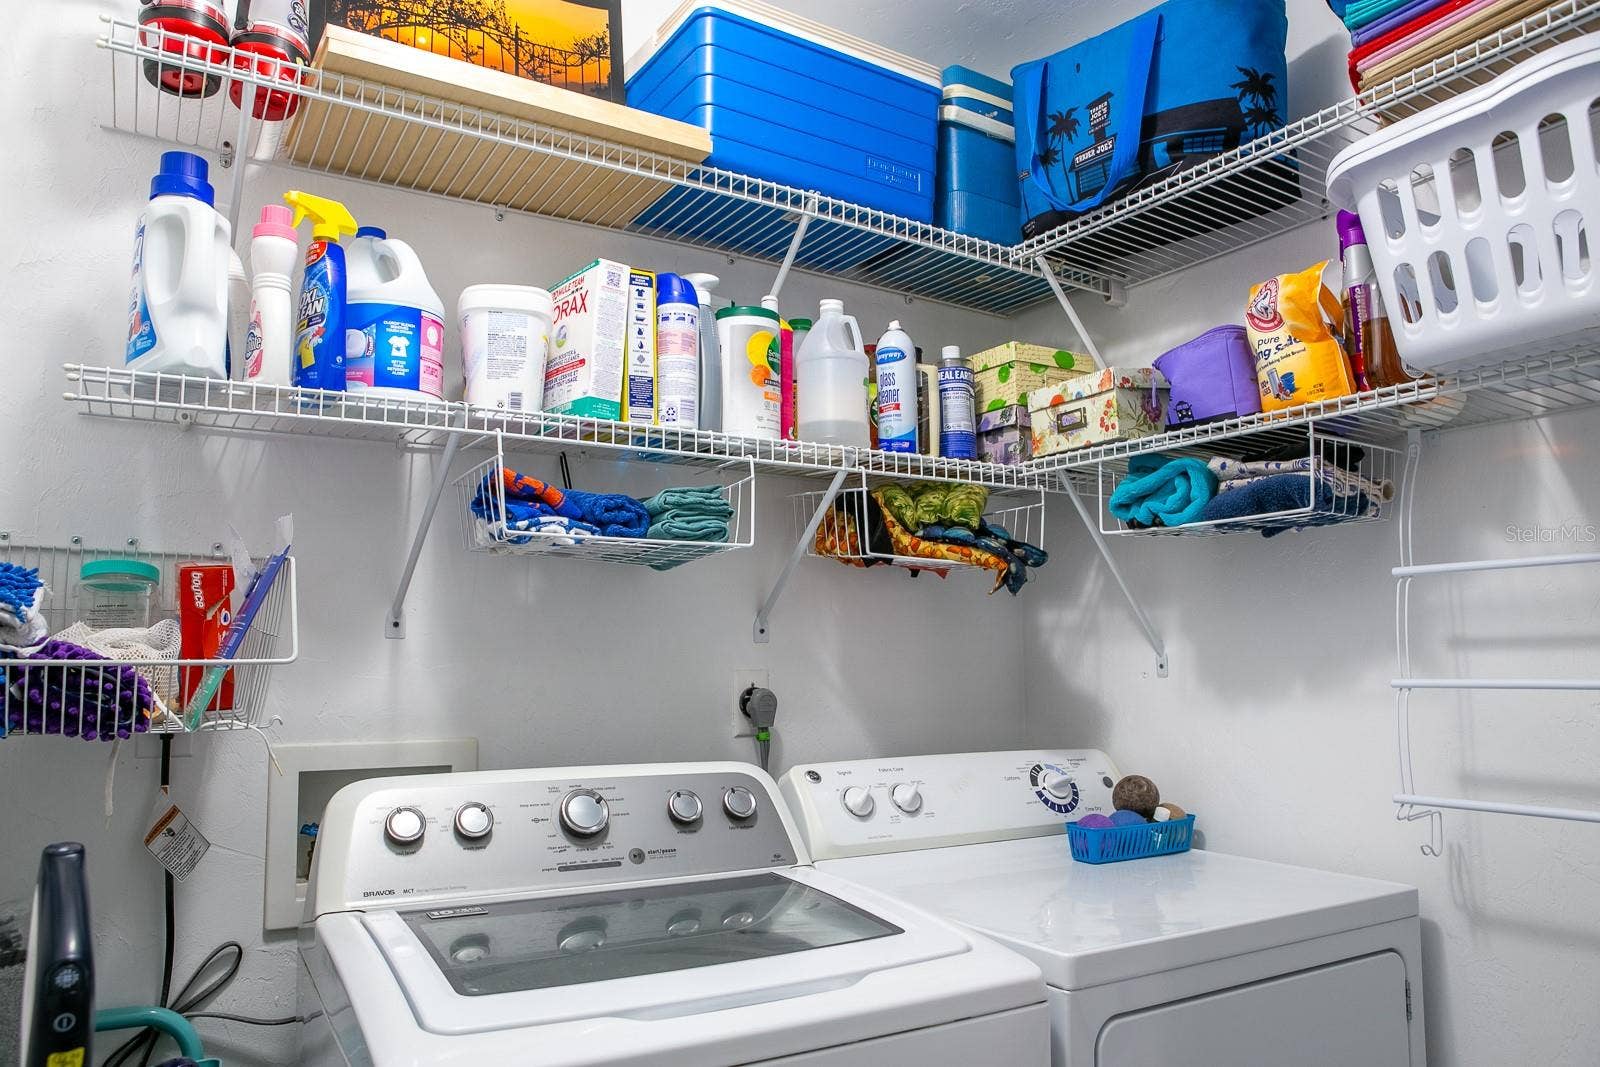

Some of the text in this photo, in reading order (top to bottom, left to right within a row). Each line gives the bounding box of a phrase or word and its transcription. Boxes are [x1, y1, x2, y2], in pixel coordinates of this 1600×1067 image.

[1090, 107, 1108, 121] JOE'S
[1075, 139, 1113, 164] TRADER JOE'S
[553, 290, 589, 325] ORAX
[1258, 336, 1280, 349] pure
[880, 371, 896, 389] glass
[191, 572, 205, 608] bounce
[363, 889, 396, 898] BRAVOS
